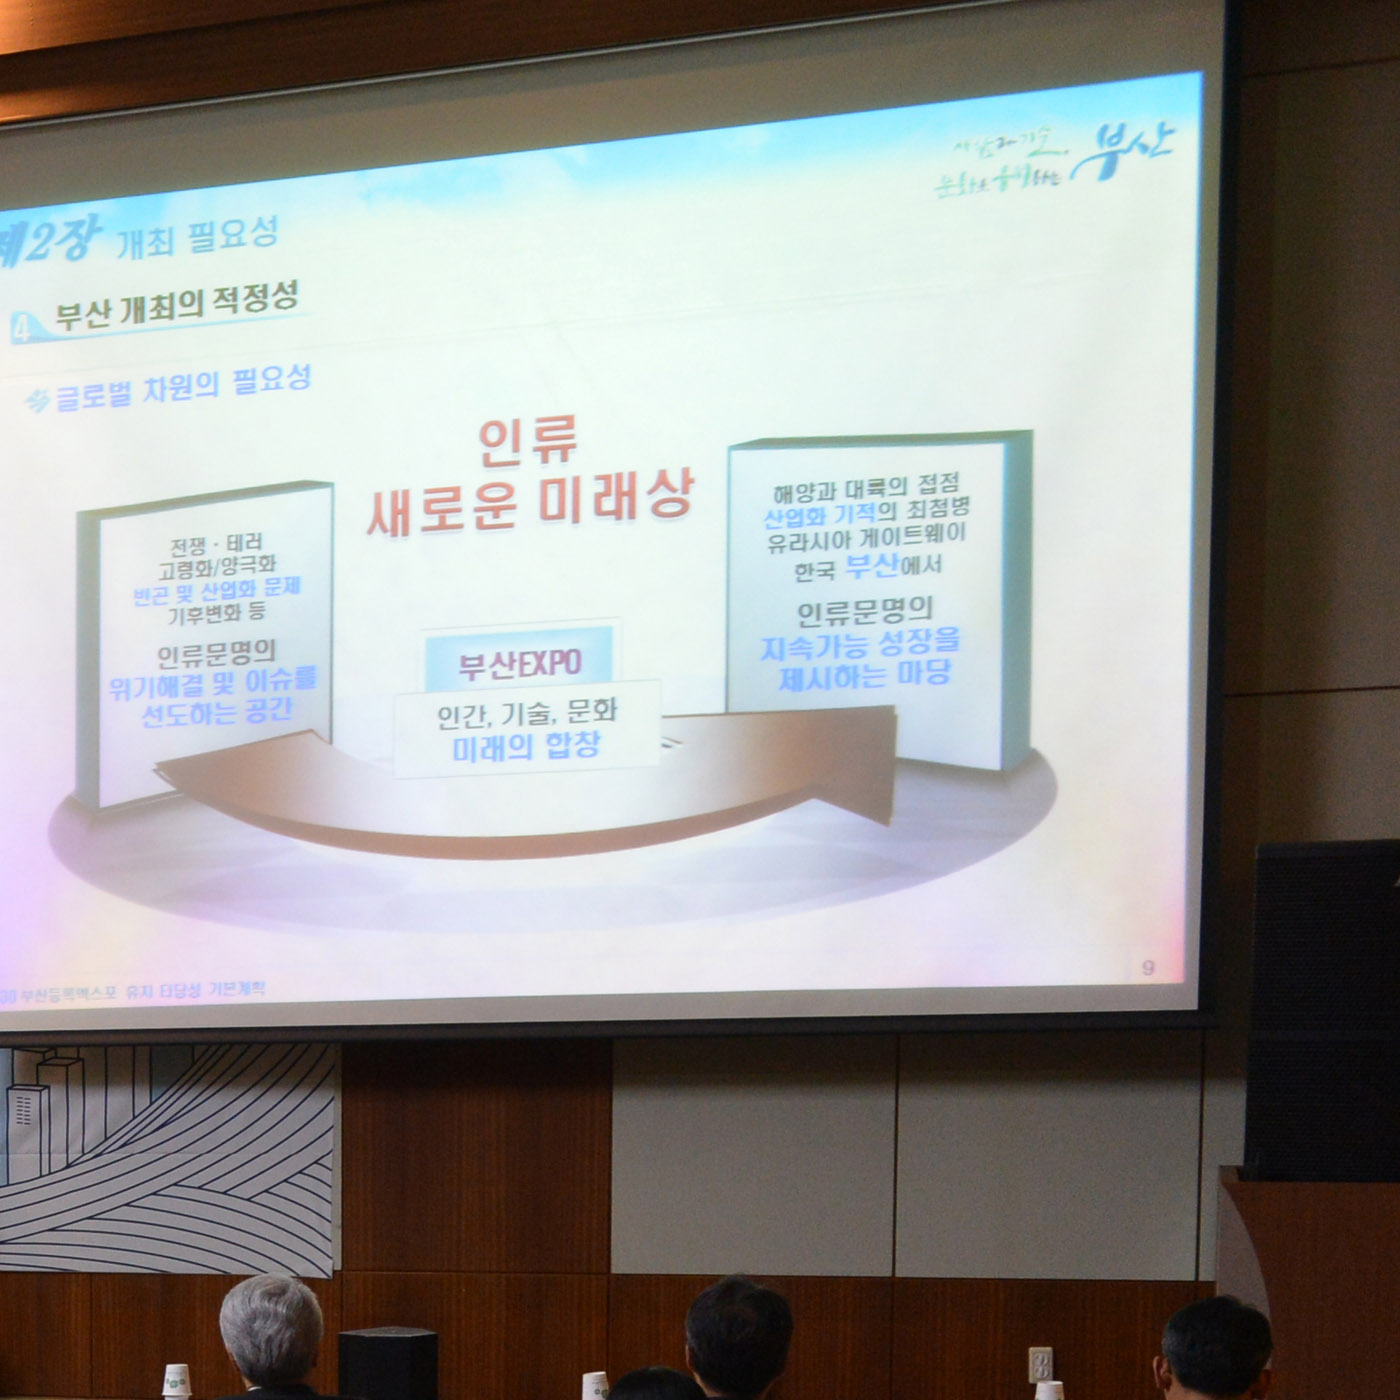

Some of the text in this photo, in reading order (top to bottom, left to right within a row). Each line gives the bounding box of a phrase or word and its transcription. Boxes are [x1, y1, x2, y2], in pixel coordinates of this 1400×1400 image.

[1069, 120, 1176, 181] 부산
[117, 226, 175, 261] 개최
[188, 215, 280, 253] 필요성
[13, 279, 300, 342] 4 부산 개최의 적정성
[56, 364, 312, 413] 글로벌 차원의 필요성
[479, 414, 577, 468] 인류
[366, 467, 695, 538] 새로운 미래상
[773, 472, 959, 505] 해양과 대륙의 접점
[764, 507, 826, 530] 산업화
[835, 502, 897, 524] 기적의
[171, 532, 262, 558] 전쟁 테러
[768, 521, 966, 554] 유라시아 게이트웨이
[158, 554, 276, 581] 고령화/양극화
[795, 553, 942, 583] 한국 부산에서
[134, 576, 301, 607] 빈곤 및 산업화 문제
[168, 602, 266, 626] 기후변화 등
[798, 596, 933, 628] 인류문명의
[157, 639, 277, 670] 인류문명의
[760, 626, 960, 662] 지속가능 성장을
[459, 649, 582, 682] 부산EXPO
[778, 658, 952, 692] 제시하는 마당
[109, 665, 317, 701] 위기해결 및 이슈를
[142, 697, 294, 729] 선도하는 공간
[438, 697, 618, 731] 인간, 기술, 문화
[453, 730, 602, 763] 미래의 합창
[1142, 960, 1155, 976] 9
